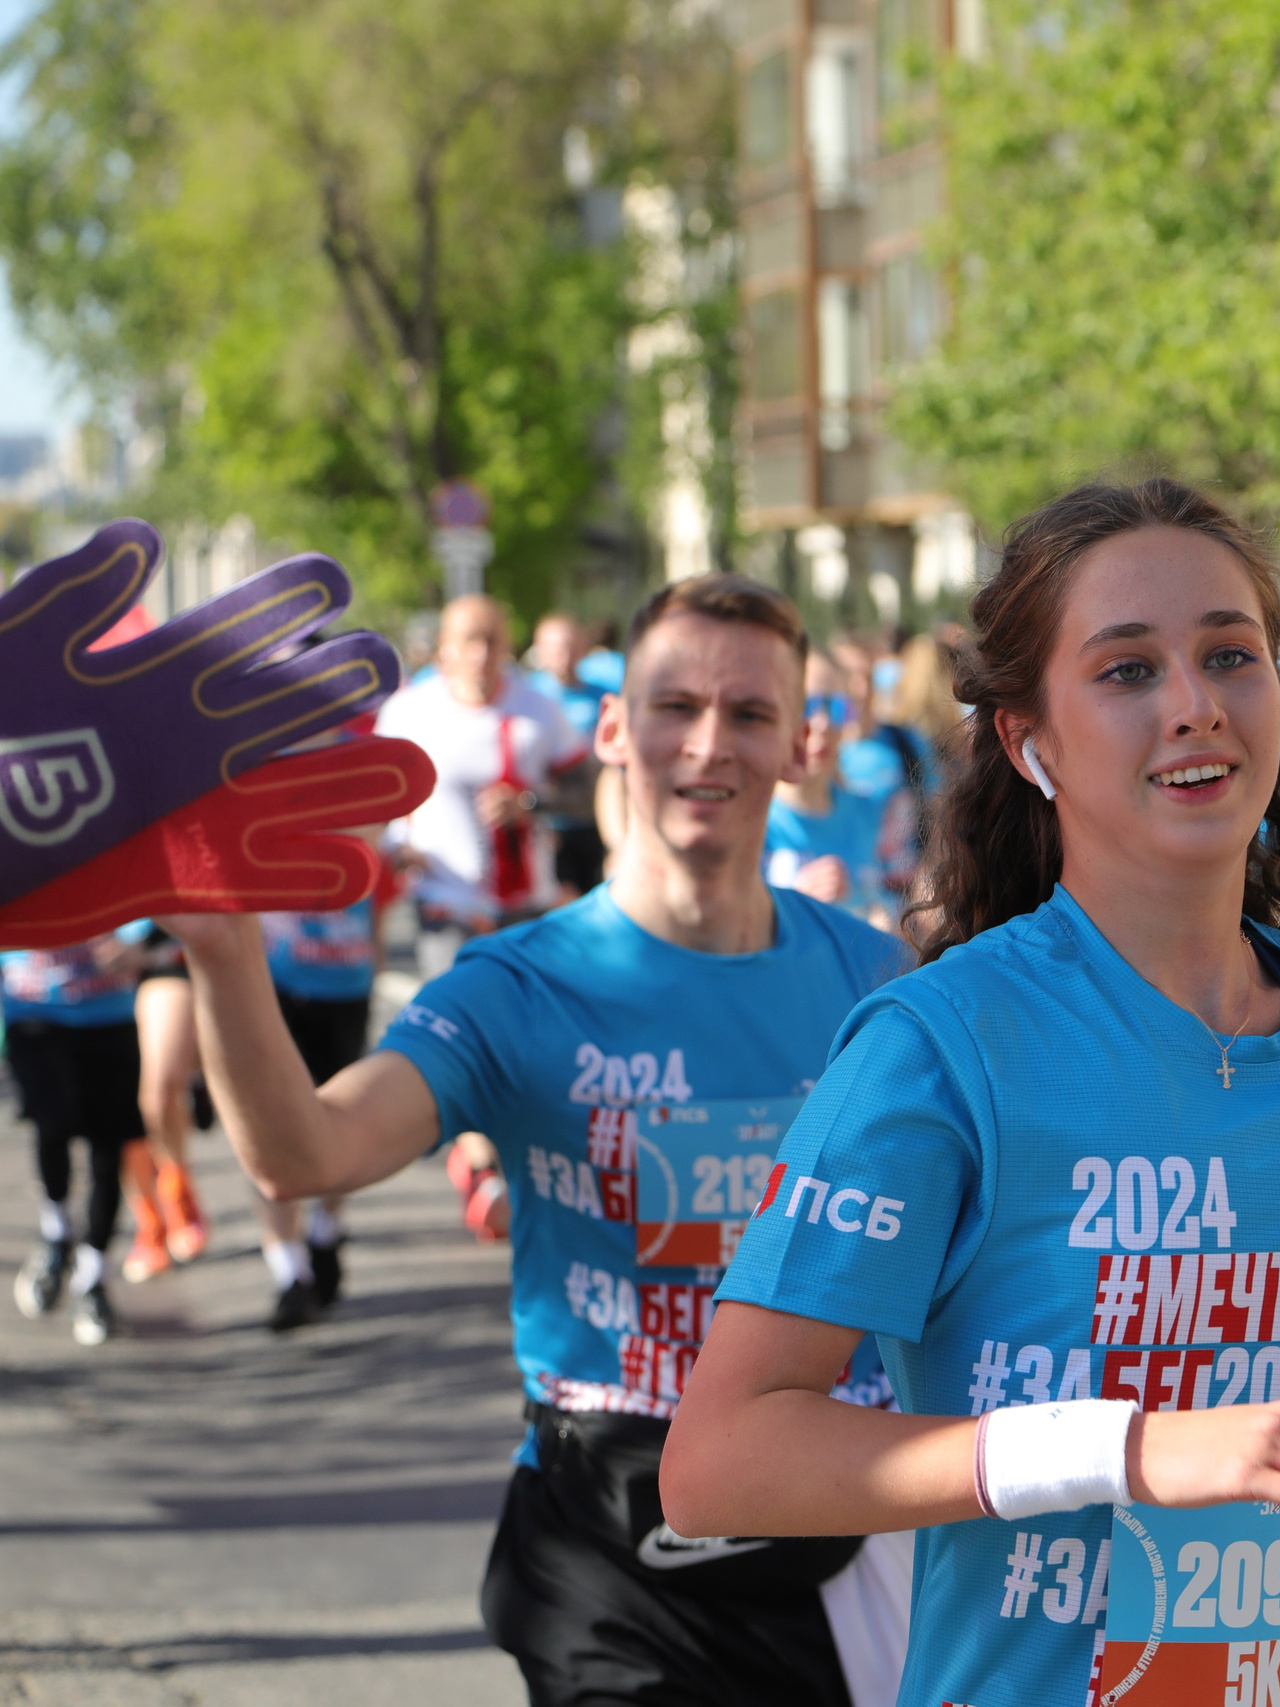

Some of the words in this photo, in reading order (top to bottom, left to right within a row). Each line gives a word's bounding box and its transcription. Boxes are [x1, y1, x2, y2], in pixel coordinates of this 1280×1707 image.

[570, 1043, 692, 1105] 2024
[785, 1175, 905, 1241] ПСБ
[1068, 1156, 1237, 1250] 2024
[1139, 1536, 1166, 1577] #ВОСТОРГ
[1151, 1577, 1168, 1634] #УДИВЛЕНИЕ
[1136, 1633, 1162, 1671] #ТРЕПЕТ
